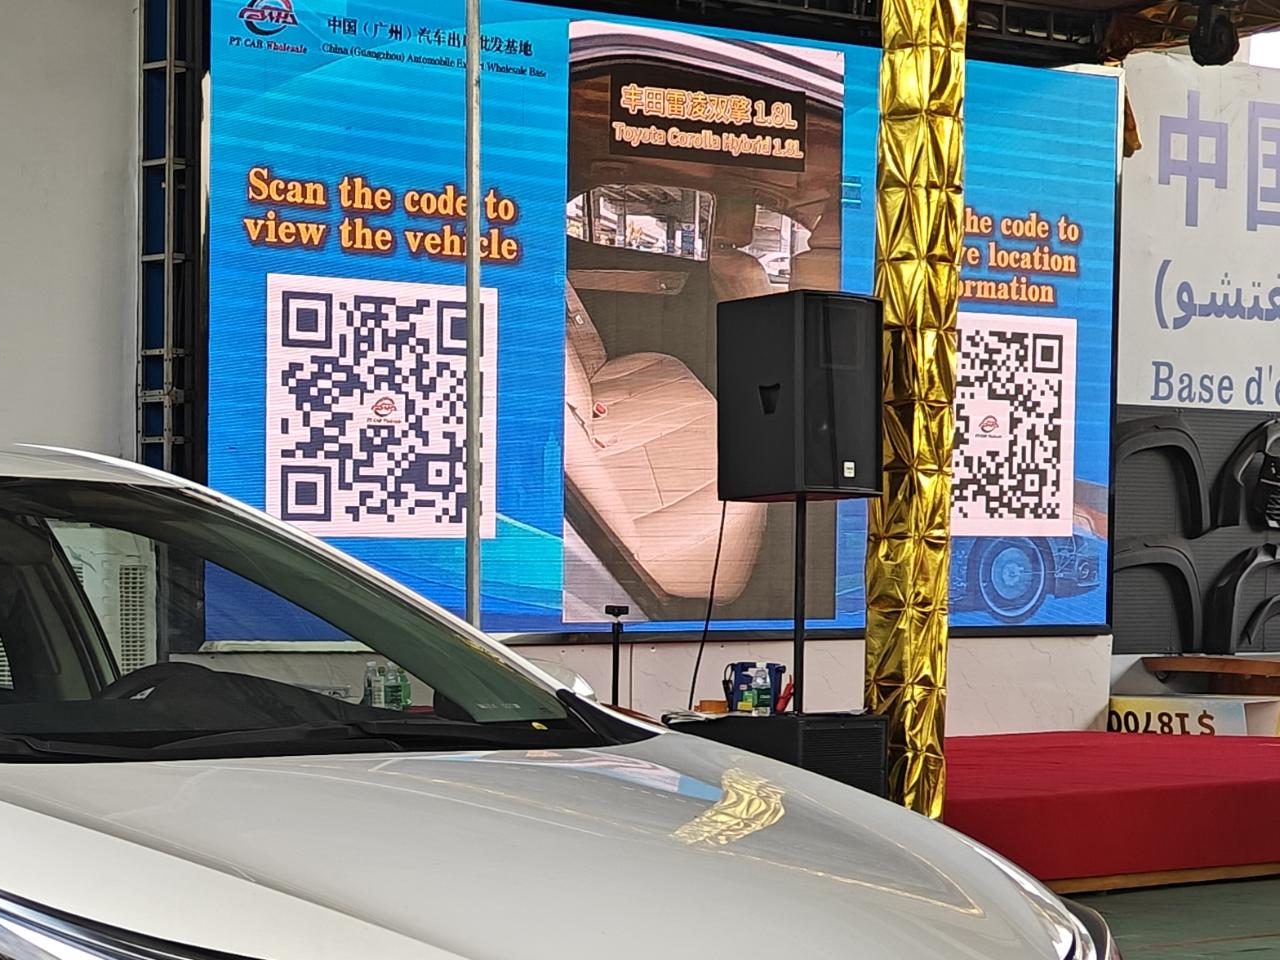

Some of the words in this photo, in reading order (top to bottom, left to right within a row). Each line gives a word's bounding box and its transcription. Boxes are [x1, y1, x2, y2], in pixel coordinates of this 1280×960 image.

[322, 42, 348, 55] China
[407, 54, 455, 68] Automobile
[327, 15, 533, 57] 中国（广州）汽车出批发基地
[621, 84, 752, 125] 丰田雷凌双擎
[754, 101, 798, 129] 1.8L
[612, 122, 666, 147] Toyota
[667, 128, 720, 150] Corolla
[722, 133, 771, 156] Hybrid
[773, 138, 804, 158] 1.8L
[248, 167, 326, 206] Scan
[338, 176, 392, 210] the
[484, 190, 515, 221] to
[243, 211, 326, 245] view
[340, 217, 392, 250] the
[405, 225, 518, 260] vehcle
[965, 207, 992, 234] he
[1000, 212, 1049, 239] code
[1058, 215, 1080, 243] to
[988, 242, 1078, 273] location
[1150, 359, 1235, 404] Base
